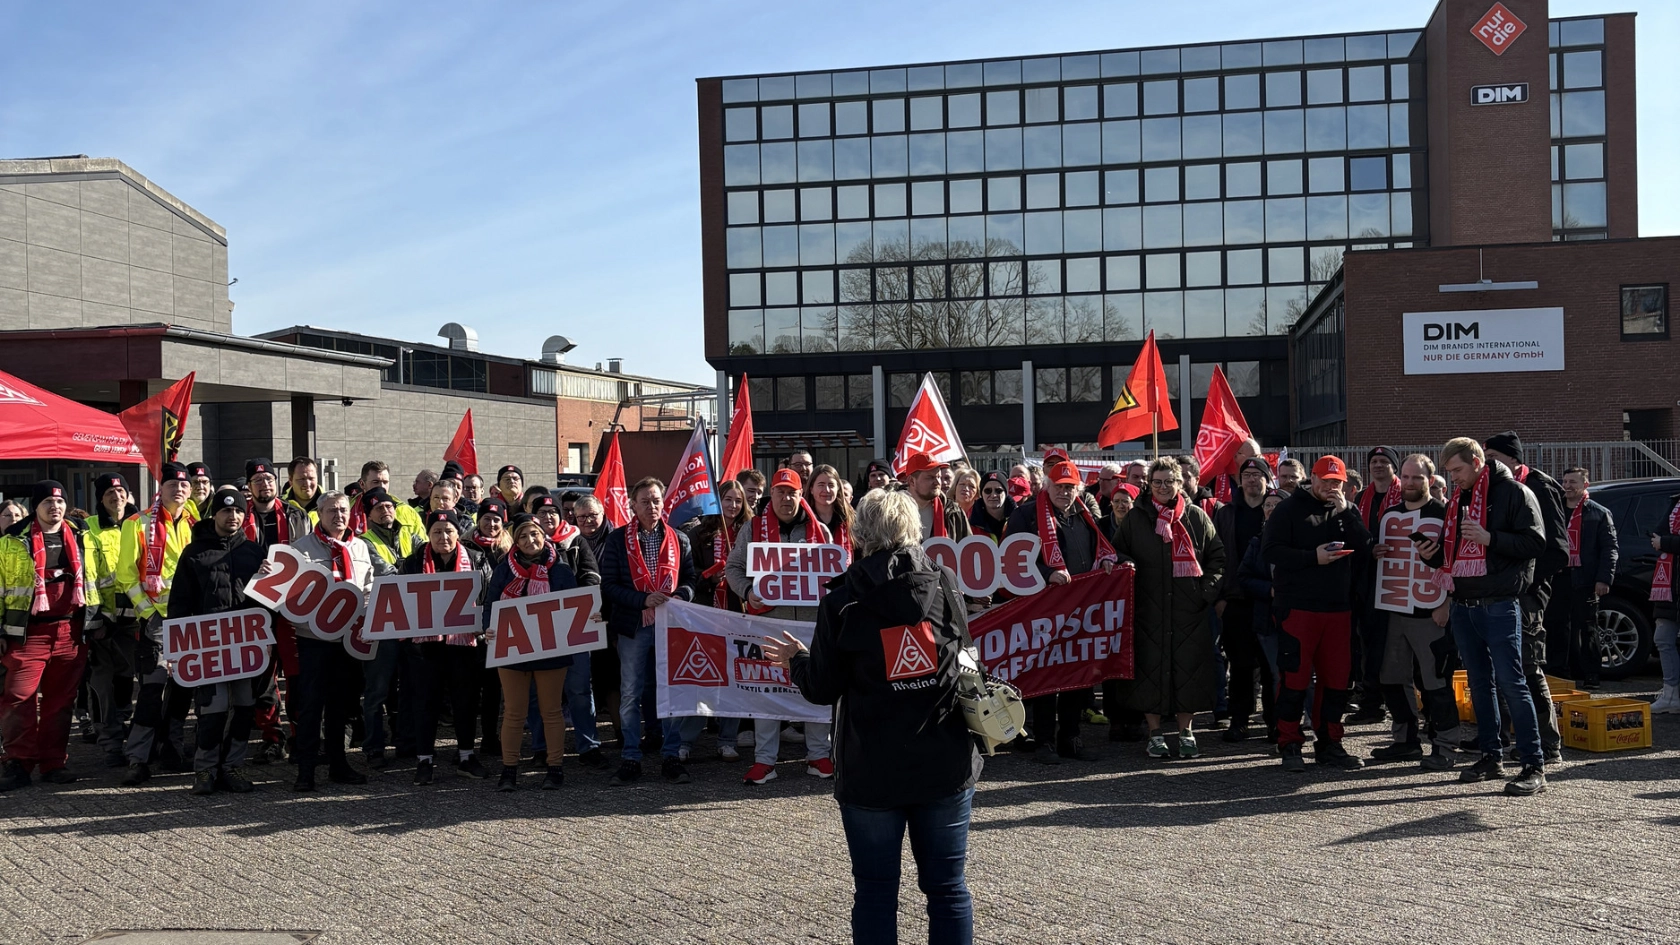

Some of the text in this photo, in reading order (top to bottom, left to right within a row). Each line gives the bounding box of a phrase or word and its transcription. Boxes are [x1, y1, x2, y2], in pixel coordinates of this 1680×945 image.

[1478, 10, 1504, 38] nur
[1492, 22, 1516, 45] die
[1477, 86, 1522, 103] DIM
[1423, 322, 1479, 341] DIM
[1441, 342, 1474, 350] BRANDS
[1476, 340, 1540, 349] INTERNATIONAL
[1463, 352, 1510, 360] GERMANY
[1513, 351, 1544, 359] GmbH
[753, 547, 843, 573] MEHR
[1380, 516, 1414, 607] MEHR
[1412, 523, 1442, 603] GED
[370, 578, 475, 633] ATZ
[169, 613, 269, 653] MEHR
[494, 594, 599, 659] ATZ
[177, 645, 264, 682] GELD
[738, 662, 787, 683] WIR
[736, 683, 762, 693] TEXTIL
[892, 677, 938, 692] Rheine
